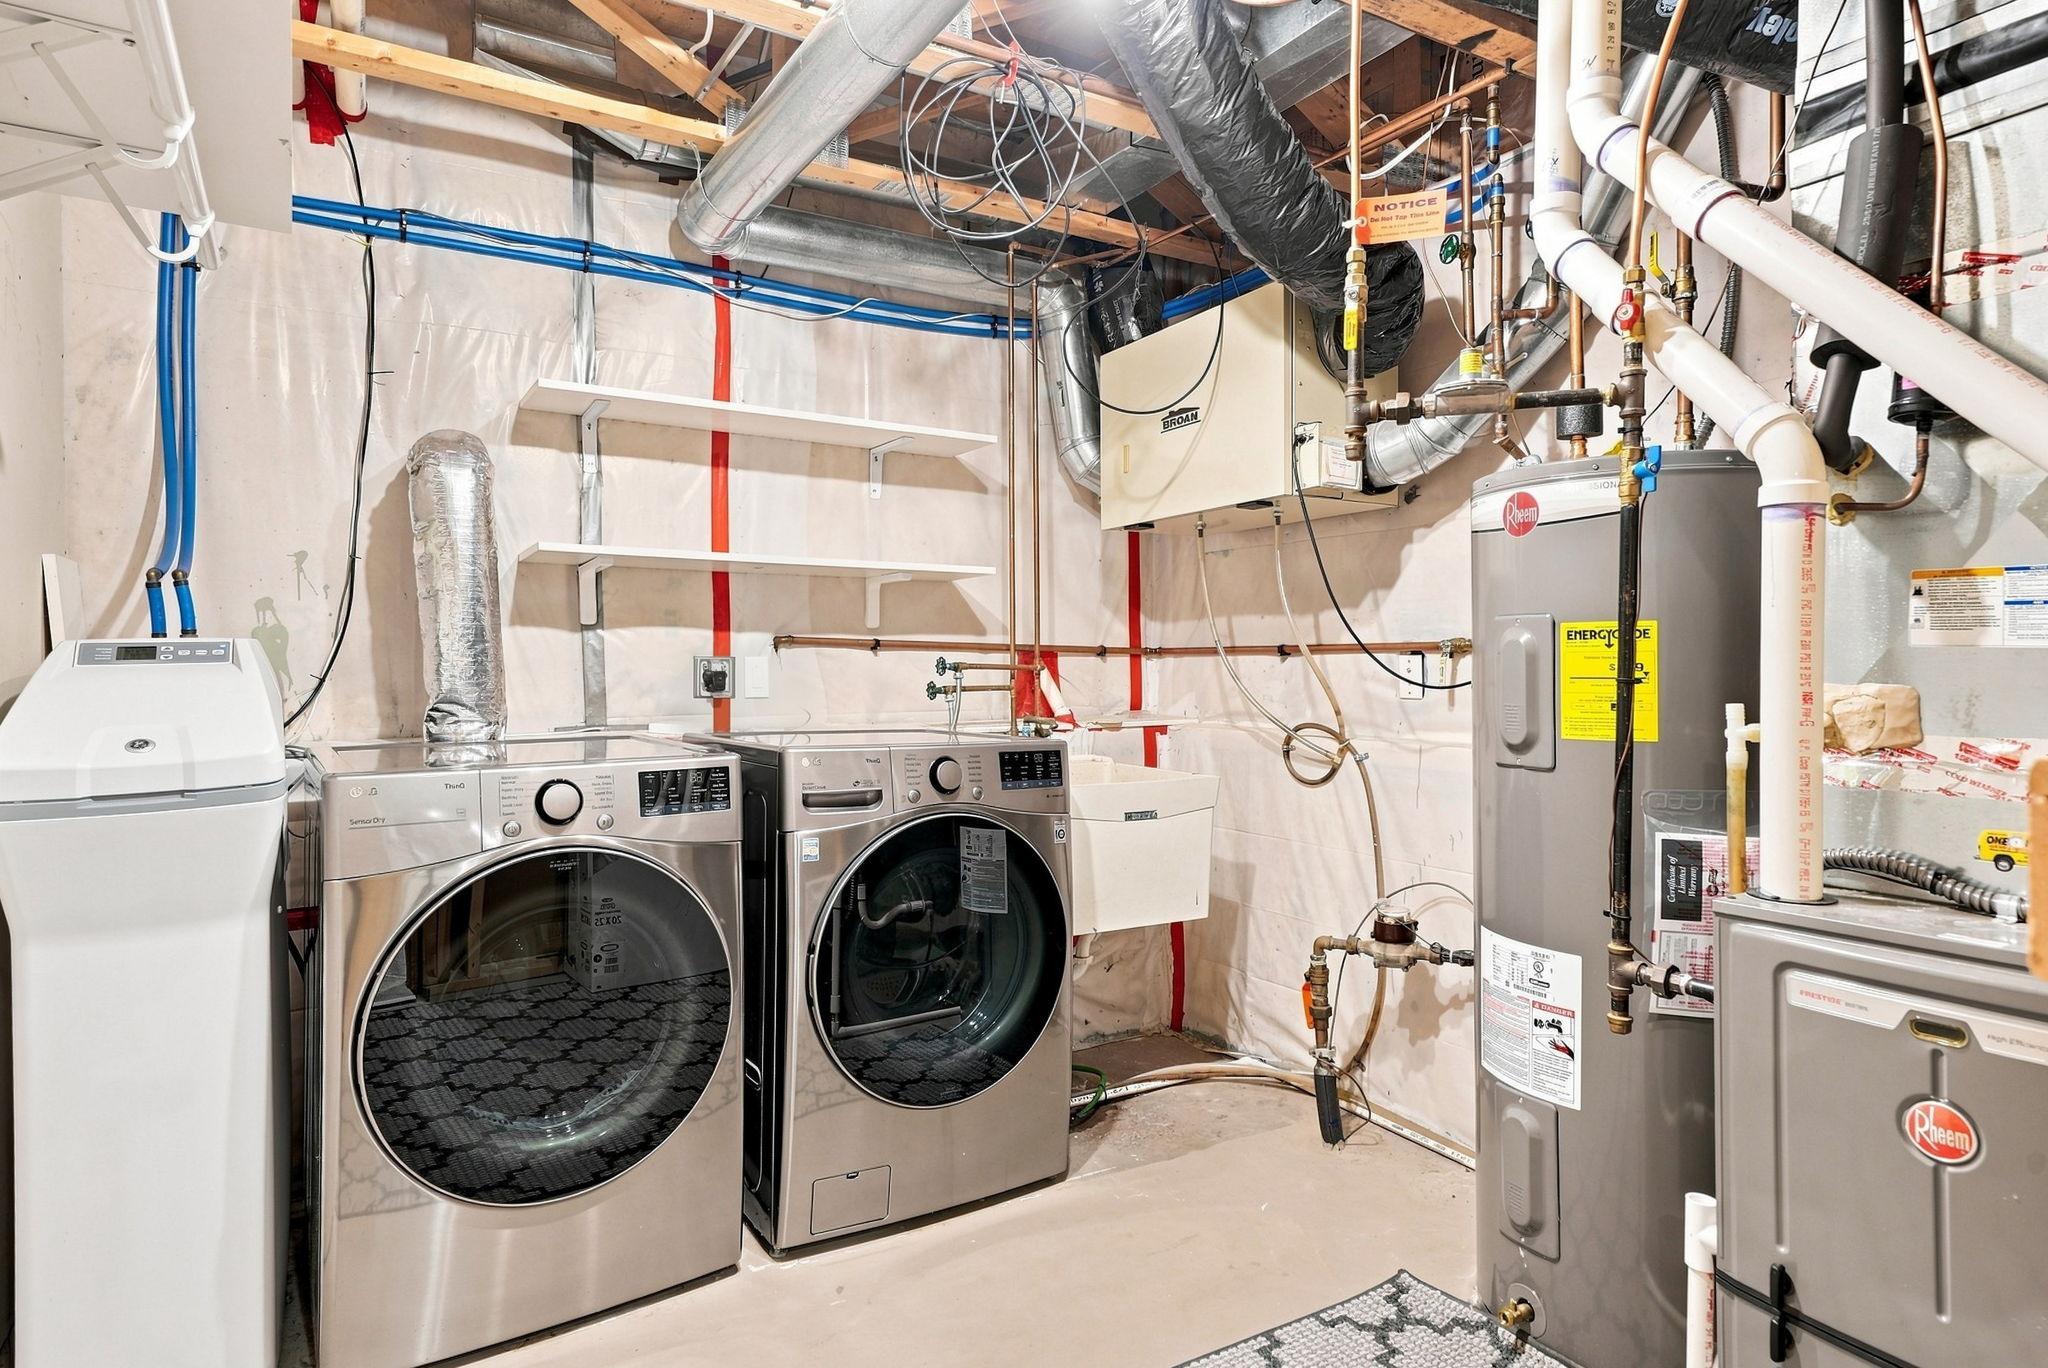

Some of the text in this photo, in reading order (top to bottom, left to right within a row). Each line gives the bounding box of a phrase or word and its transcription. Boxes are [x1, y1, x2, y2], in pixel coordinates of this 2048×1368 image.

[1374, 197, 1438, 212] NOTICE
[1162, 411, 1199, 430] BROAN
[1506, 492, 1537, 530] Rheem
[1567, 629, 1651, 640] ENERGYGDE
[444, 782, 466, 790] ThinQ
[1667, 854, 1680, 904] Certificate of
[1677, 865, 1687, 894] Limited
[1688, 865, 1699, 898] Warranty
[1541, 1004, 1575, 1019] DANGER
[1914, 1105, 1971, 1152] Rheem
